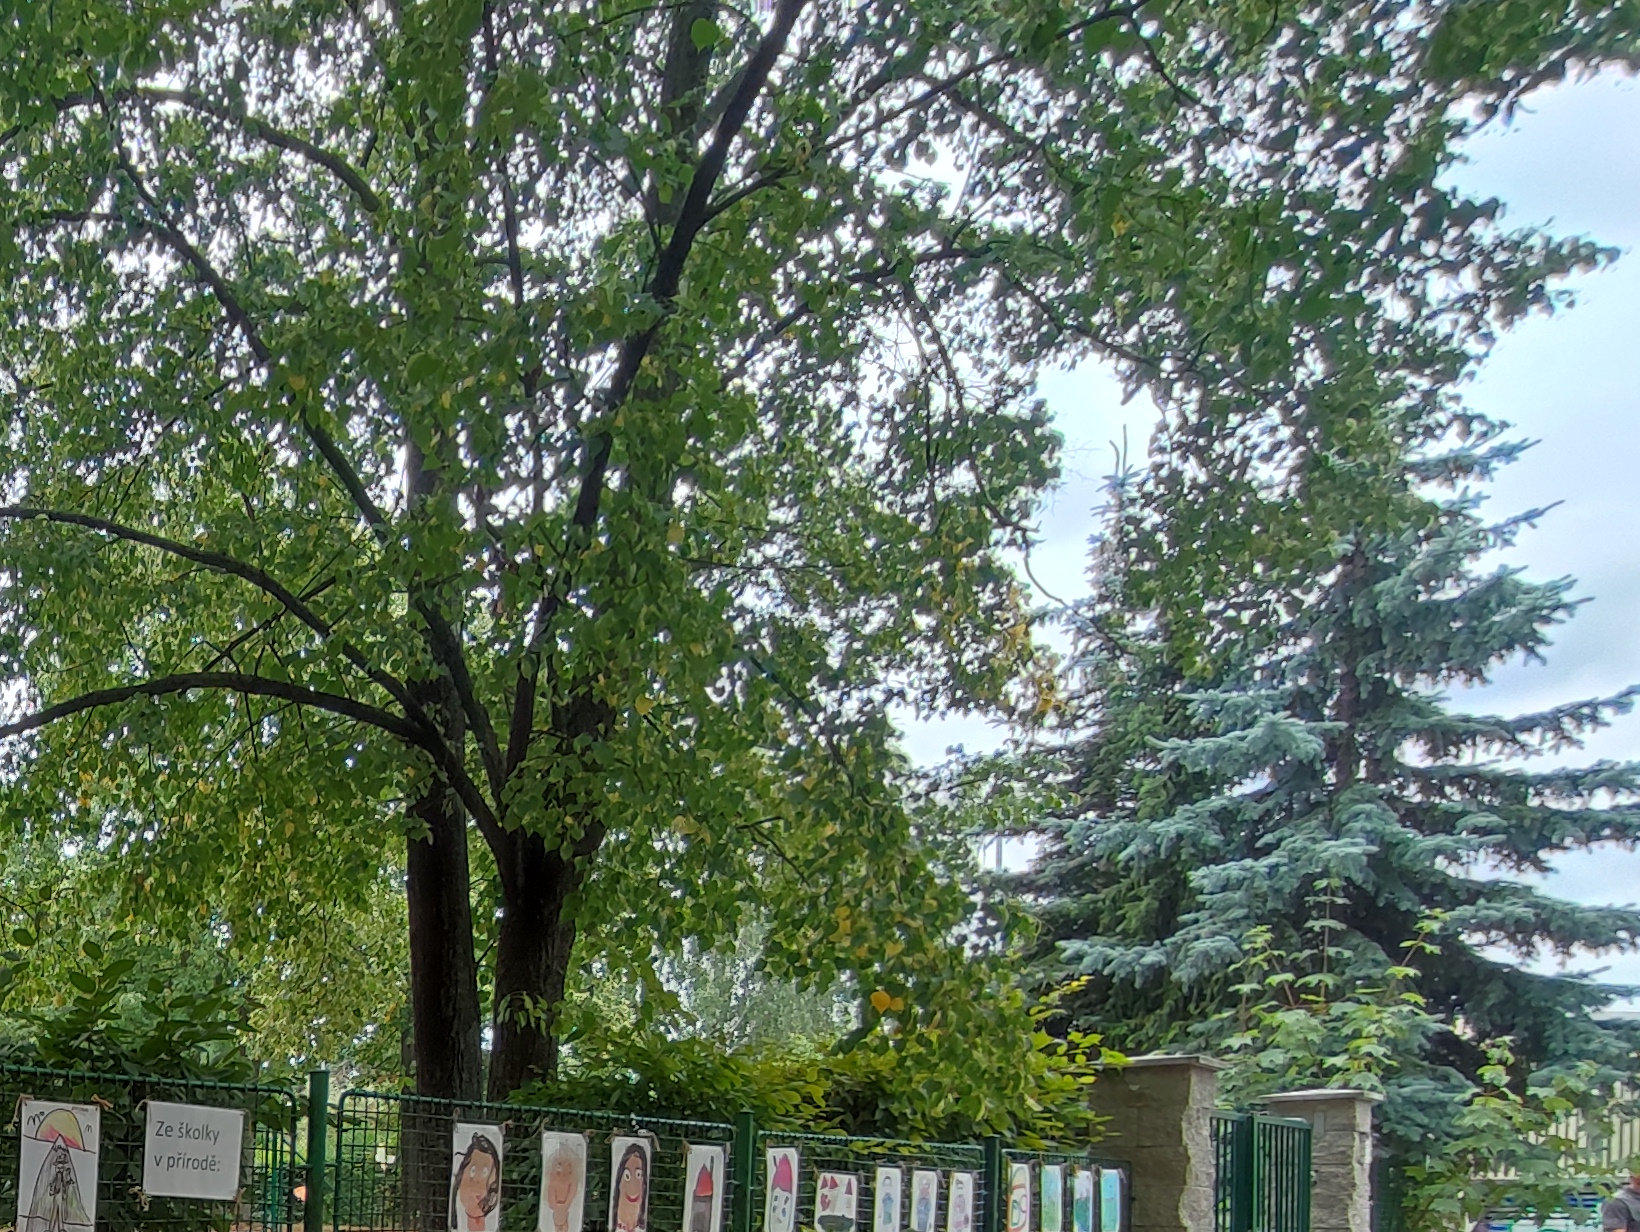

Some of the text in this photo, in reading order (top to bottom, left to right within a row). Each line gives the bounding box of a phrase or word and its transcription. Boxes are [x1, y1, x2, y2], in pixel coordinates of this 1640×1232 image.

[155, 1120, 220, 1145] Ze školky
[154, 1151, 221, 1172] v přírodě:
